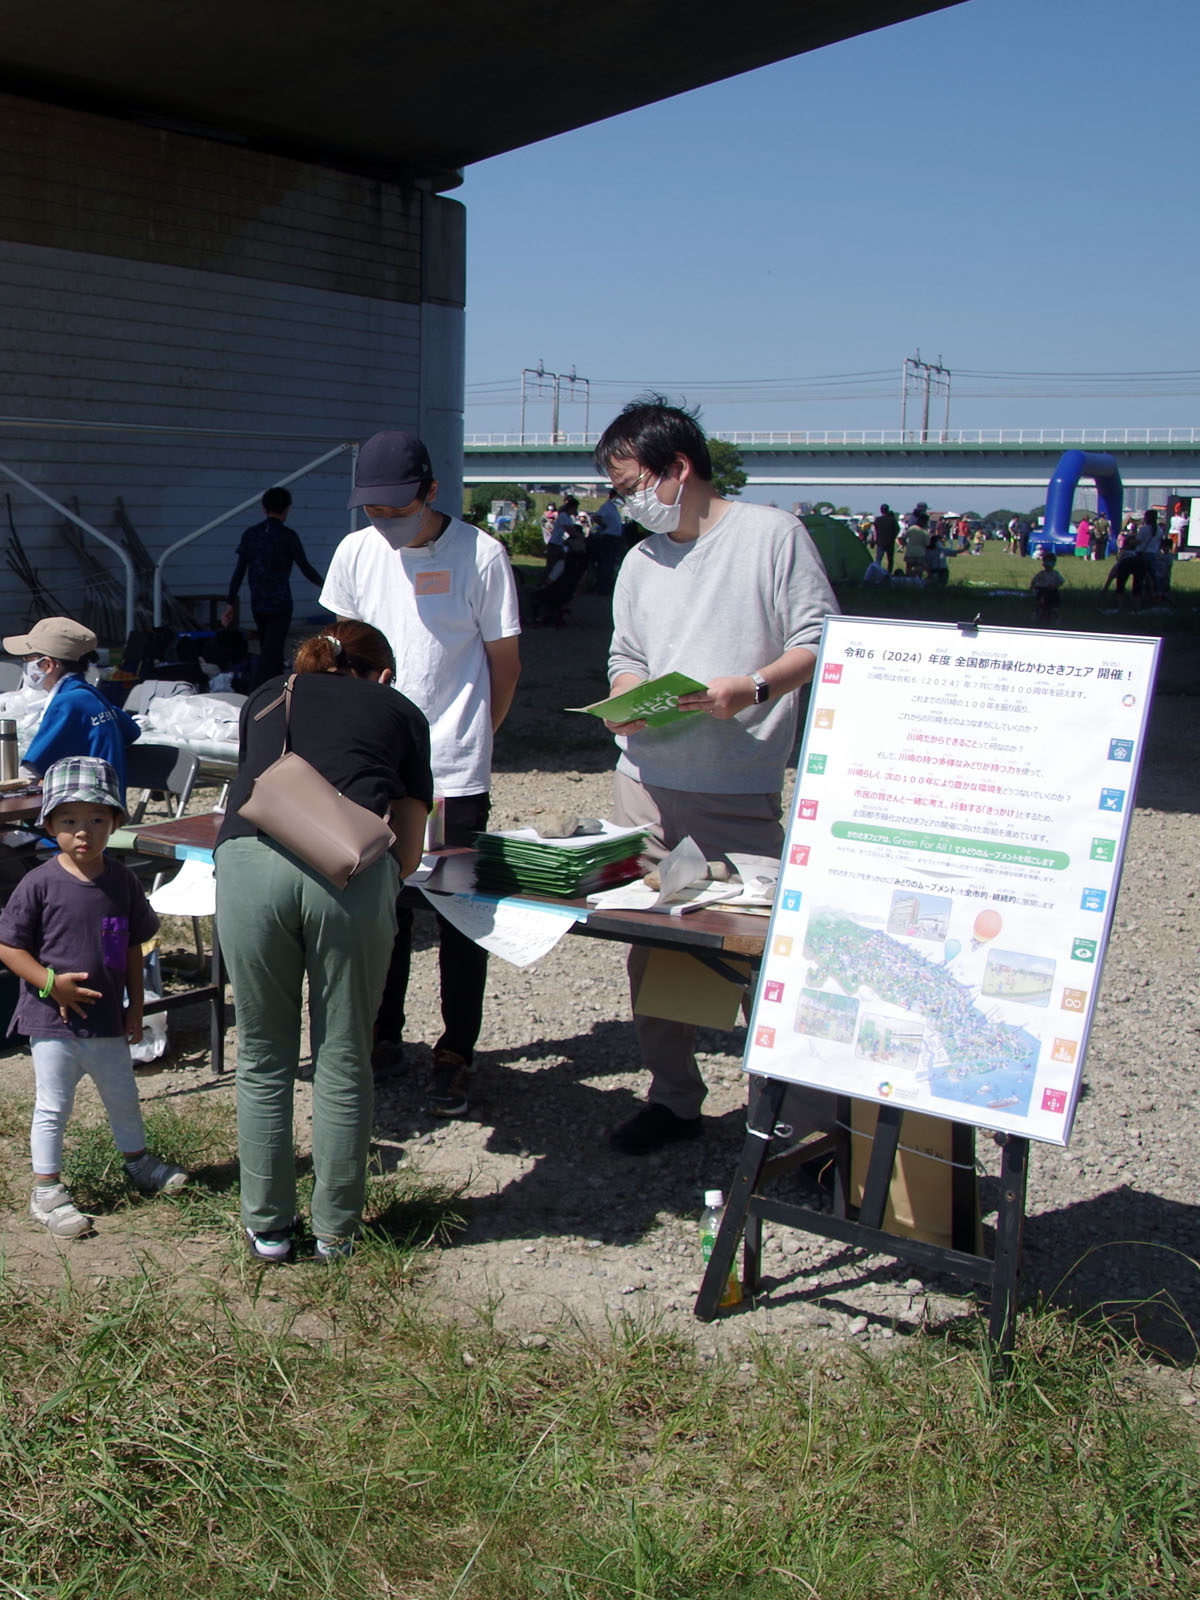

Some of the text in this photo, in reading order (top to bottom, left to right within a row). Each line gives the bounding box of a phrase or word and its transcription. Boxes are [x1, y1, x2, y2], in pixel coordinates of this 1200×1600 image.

[953, 655, 1094, 678] 全国都市緑化かわさきフェア
